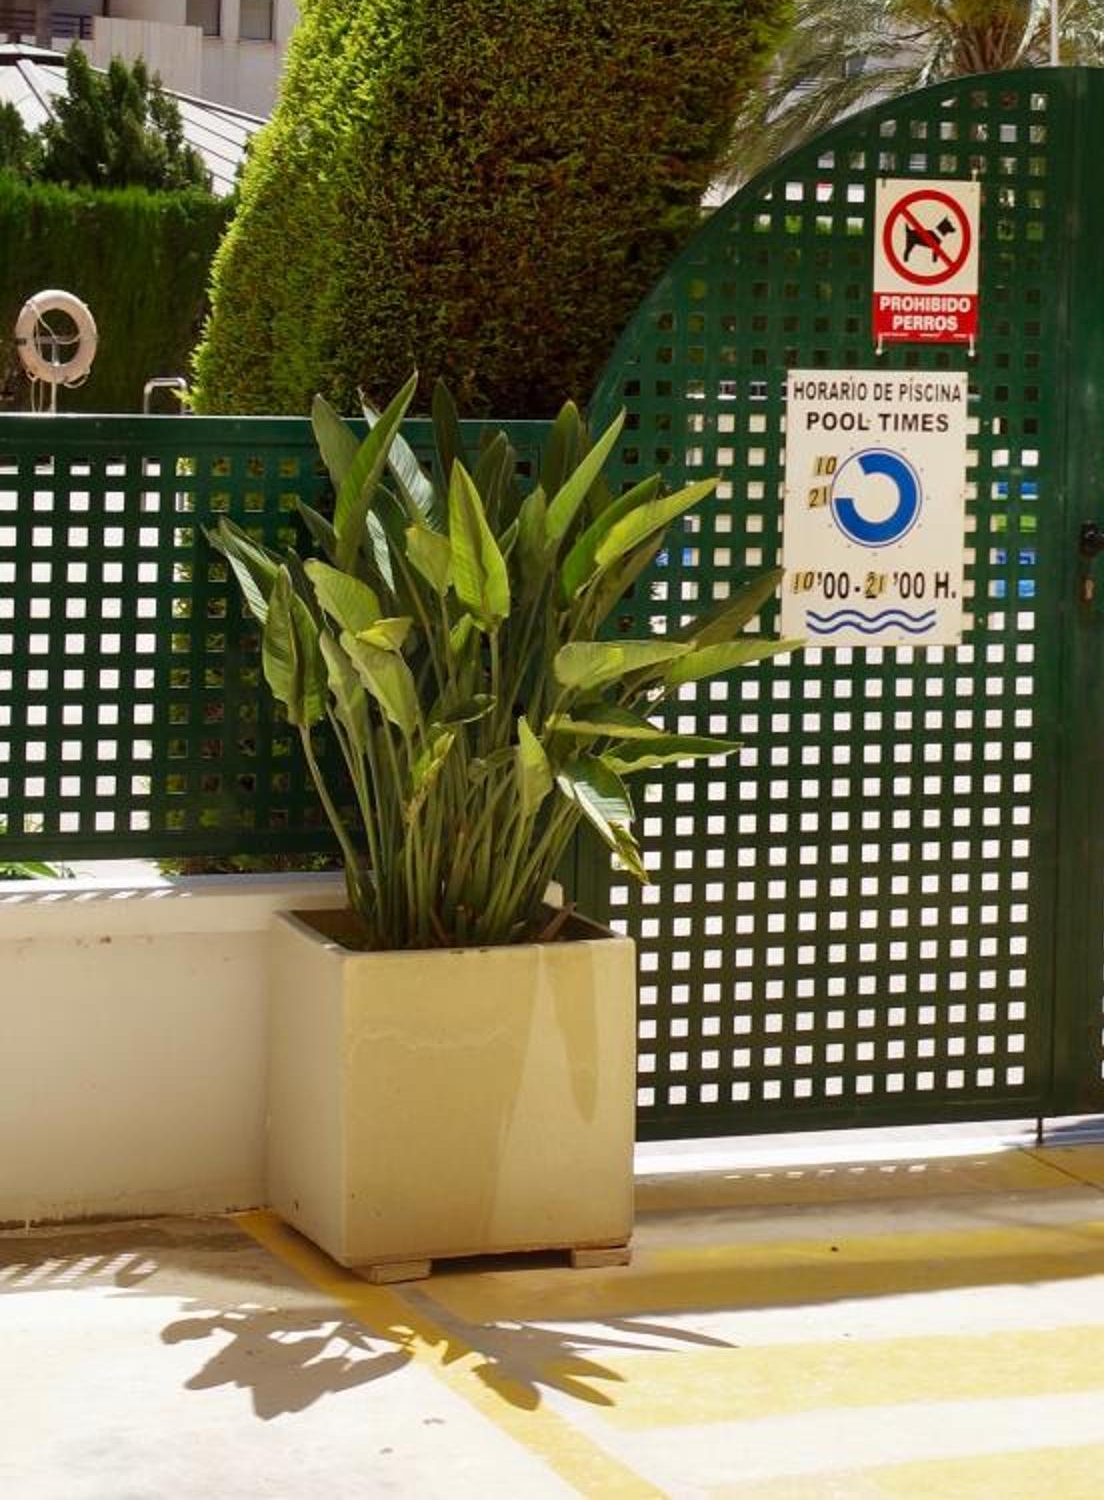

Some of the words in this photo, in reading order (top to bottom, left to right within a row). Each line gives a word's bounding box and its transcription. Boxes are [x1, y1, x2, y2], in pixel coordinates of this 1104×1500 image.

[879, 295, 971, 313] PROHIBIDO
[892, 316, 958, 332] PERROS
[873, 382, 893, 402] DE
[806, 411, 869, 431] POOL
[878, 412, 949, 432] TIMES
[815, 455, 838, 476] 10
[808, 485, 828, 508] 21
[934, 571, 957, 599] H.
